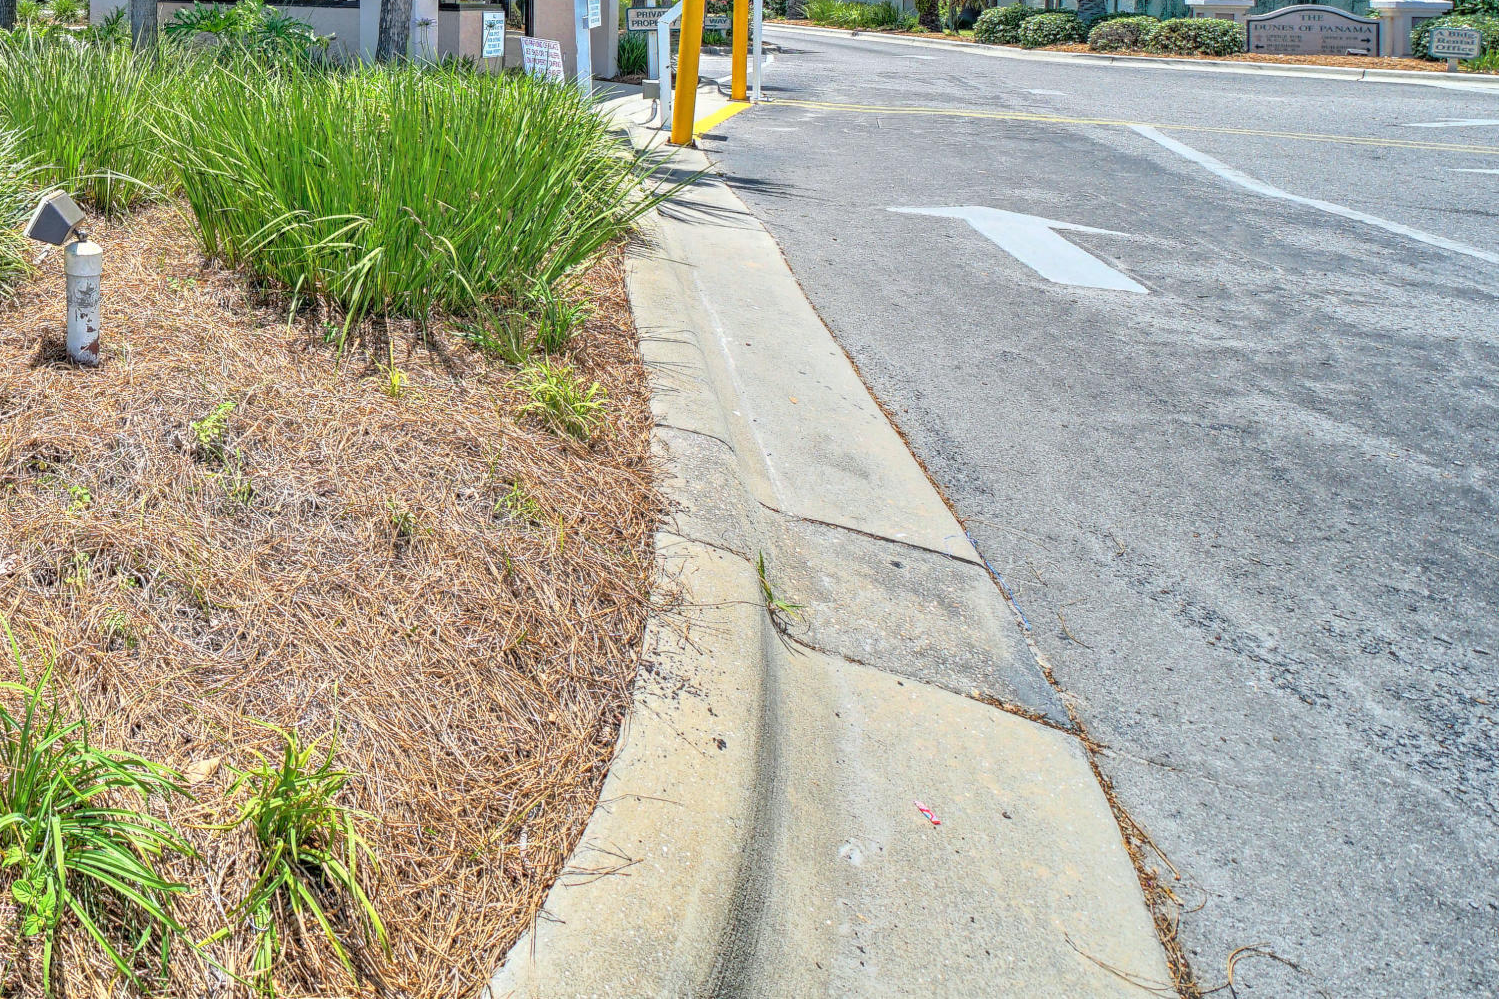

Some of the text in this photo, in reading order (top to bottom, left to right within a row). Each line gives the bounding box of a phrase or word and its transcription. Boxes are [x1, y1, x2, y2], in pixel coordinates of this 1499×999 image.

[1320, 25, 1372, 33] PANAMA
[1437, 38, 1475, 46] Rental
[1436, 44, 1475, 52] Office
